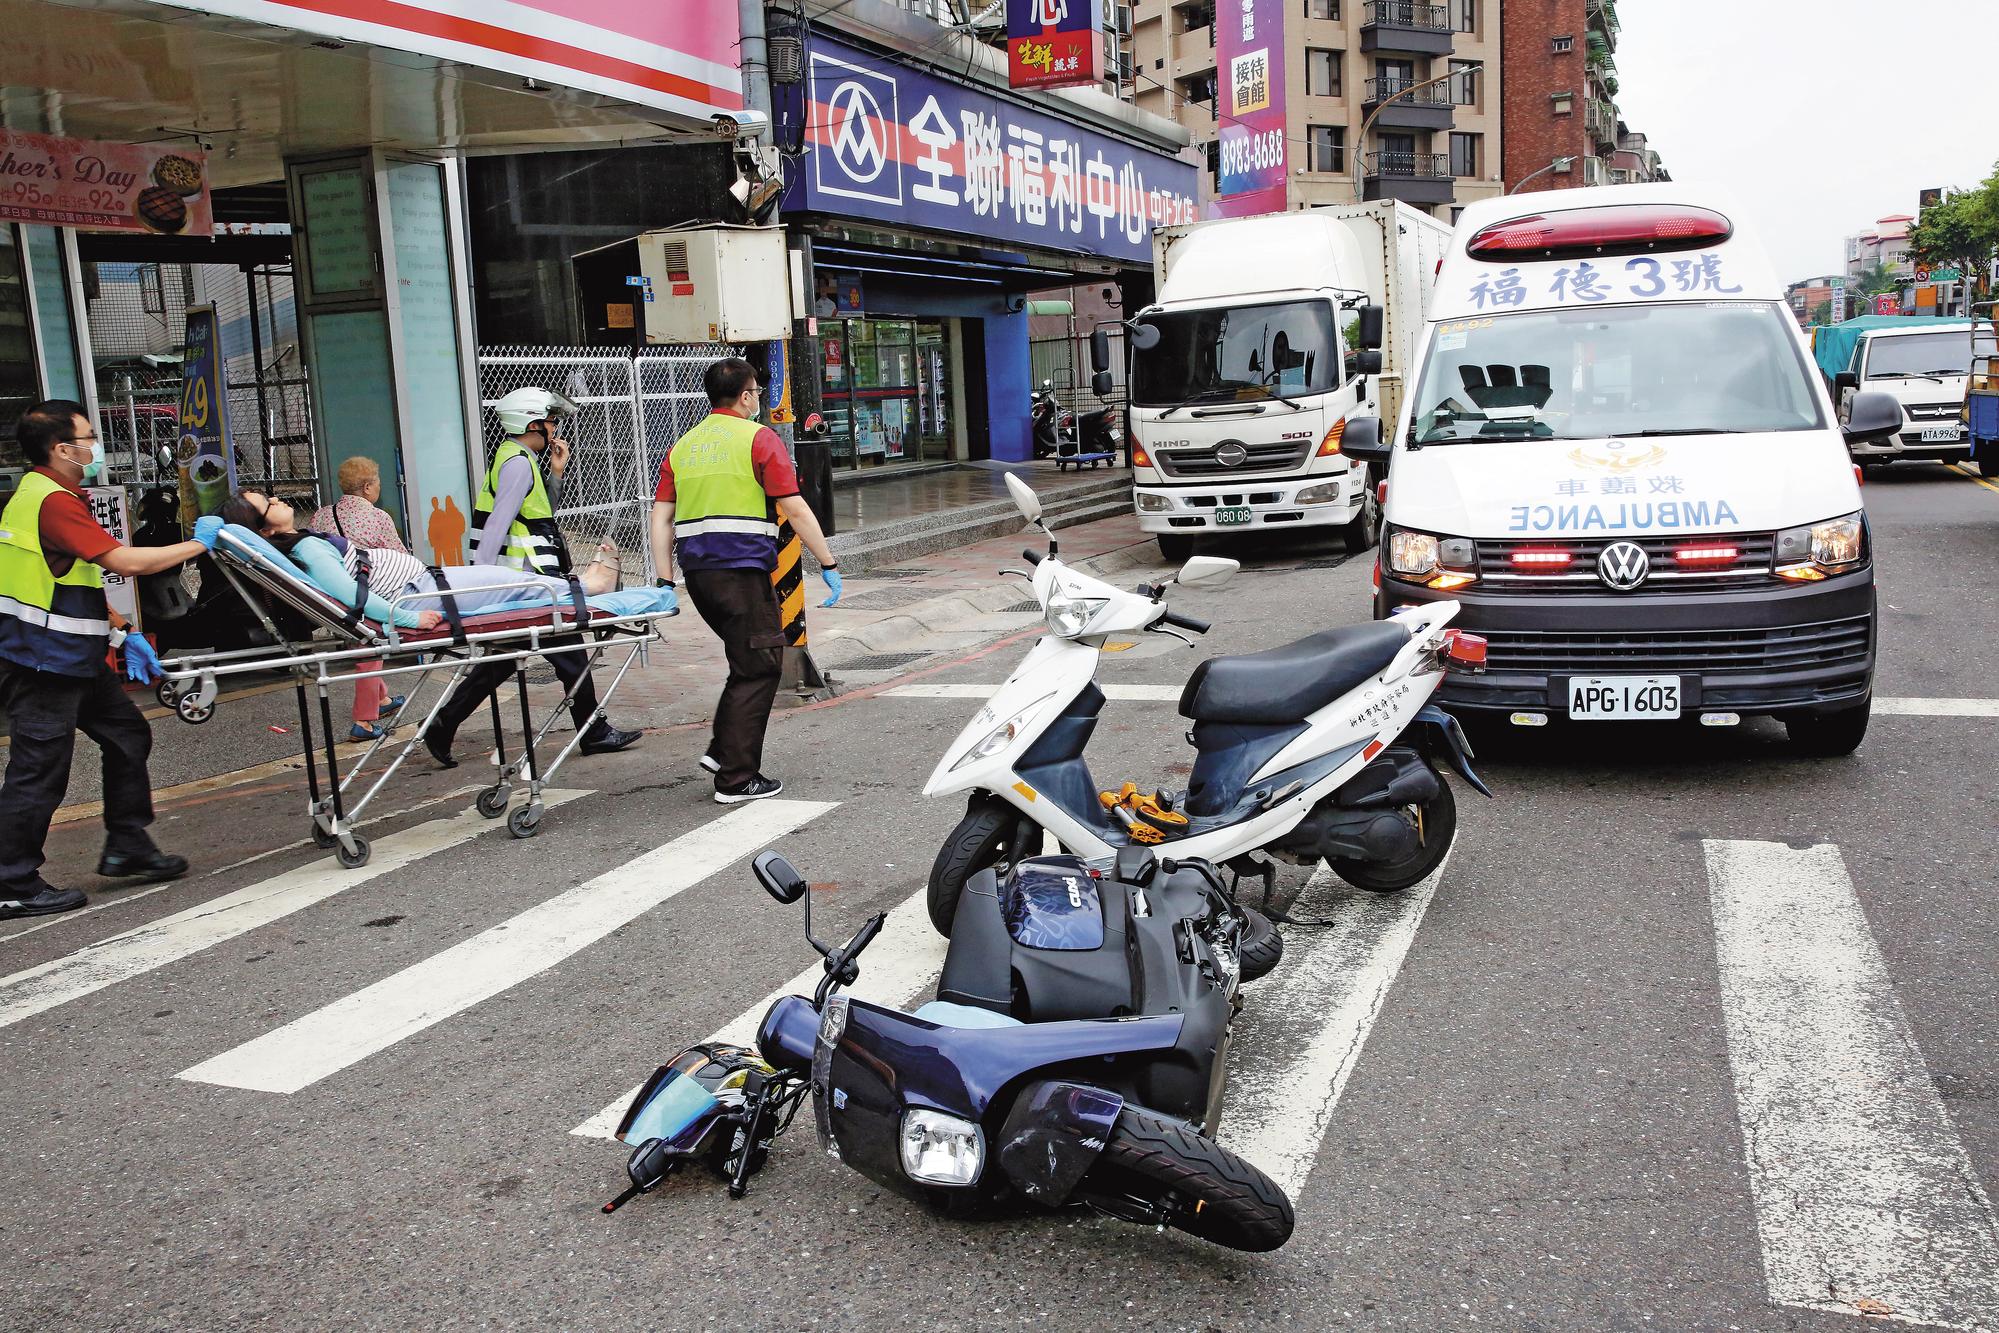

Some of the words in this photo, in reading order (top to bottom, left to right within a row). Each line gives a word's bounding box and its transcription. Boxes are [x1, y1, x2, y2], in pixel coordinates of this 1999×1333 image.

[1017, 38, 1054, 74] 生鮮
[1235, 57, 1265, 85] 接待
[1235, 80, 1265, 109] 會館
[908, 94, 1147, 245] 全聯福利中心
[1223, 128, 1284, 177] 8983-8688
[0, 151, 62, 181] her's
[73, 156, 137, 194] Day
[1467, 254, 1743, 309] 福德3號
[182, 375, 209, 430] 49
[690, 441, 721, 454] EMT
[1572, 686, 1678, 713] APG-1603
